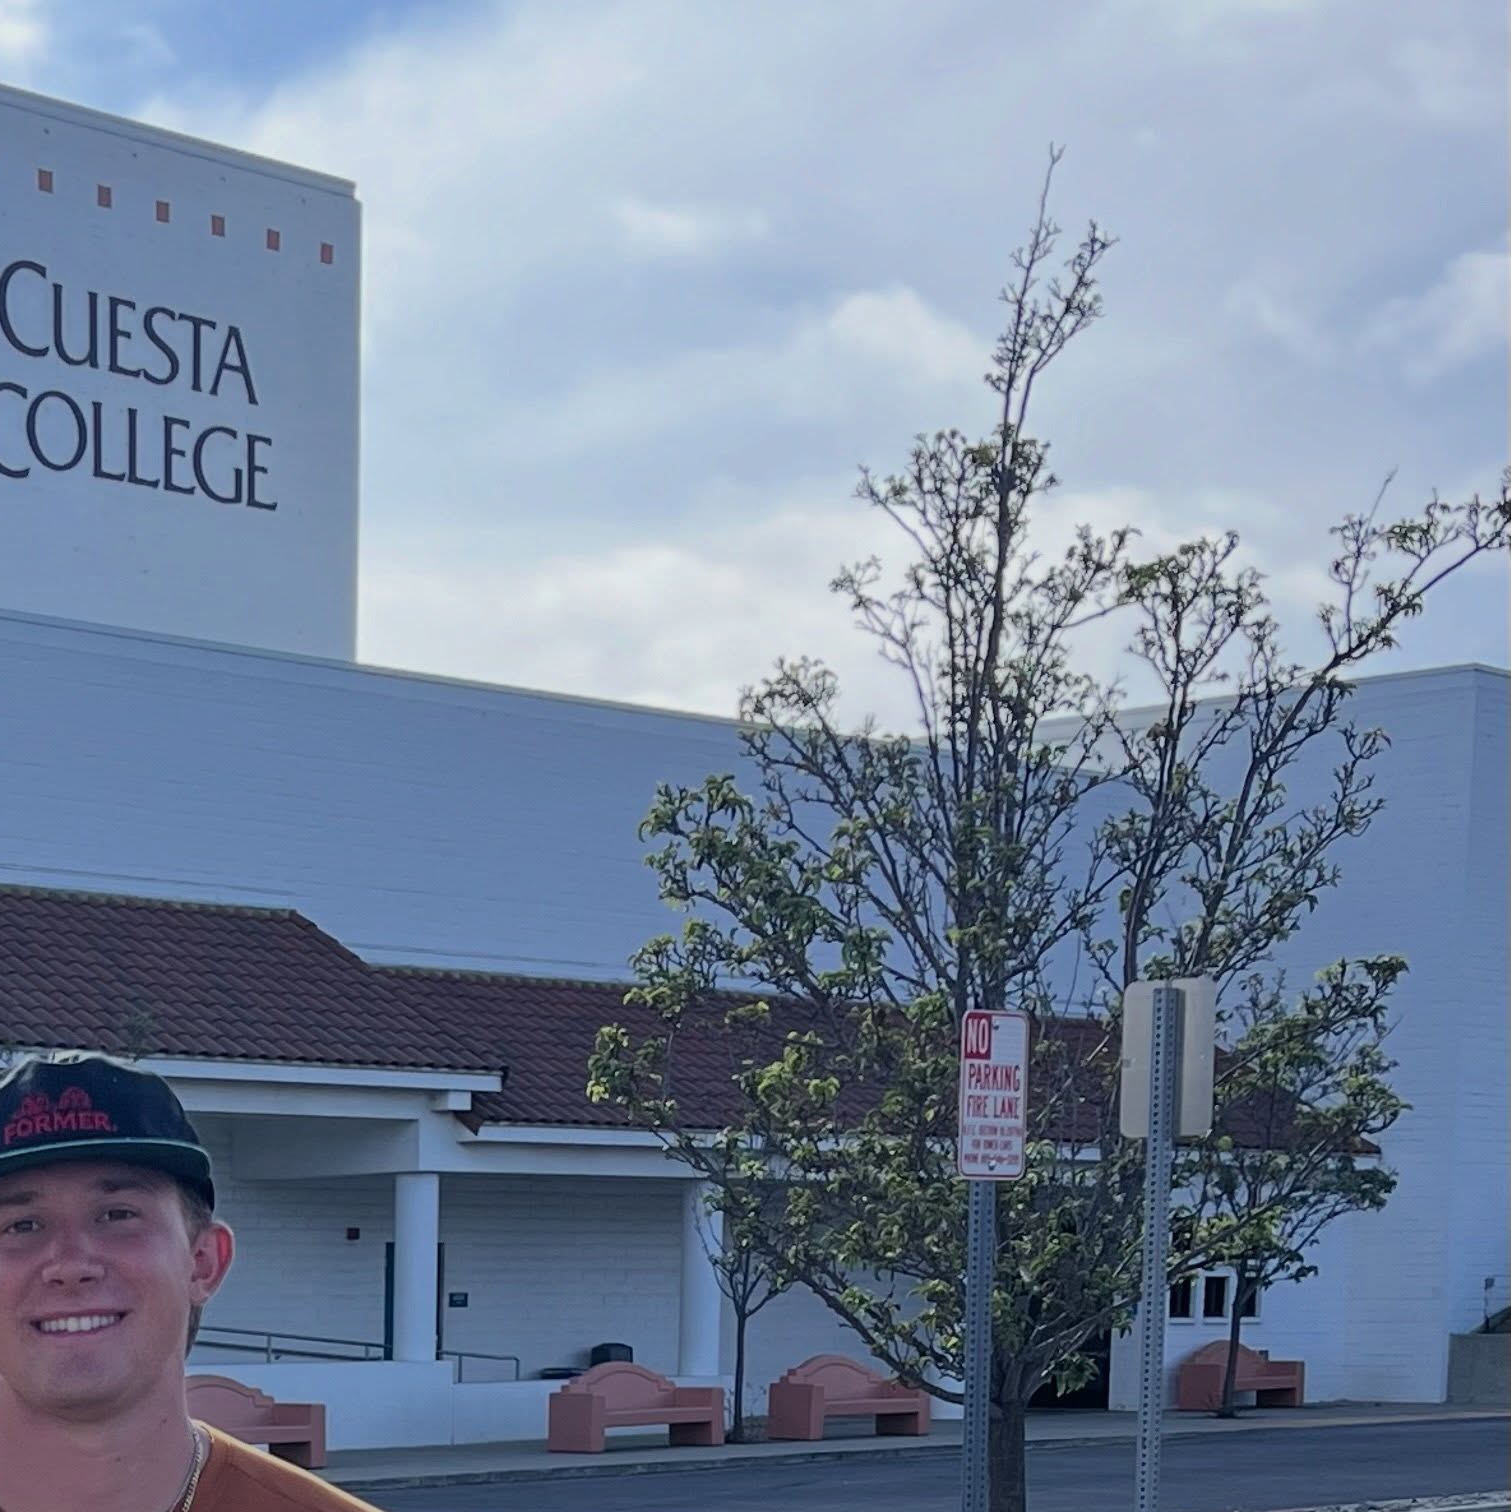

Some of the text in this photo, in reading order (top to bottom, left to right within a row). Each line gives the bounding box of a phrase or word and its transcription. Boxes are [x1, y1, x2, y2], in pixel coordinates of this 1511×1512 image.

[967, 1018, 988, 1054] NO
[968, 1063, 1020, 1091] PARKING
[967, 1095, 1020, 1119] FIRE LANE
